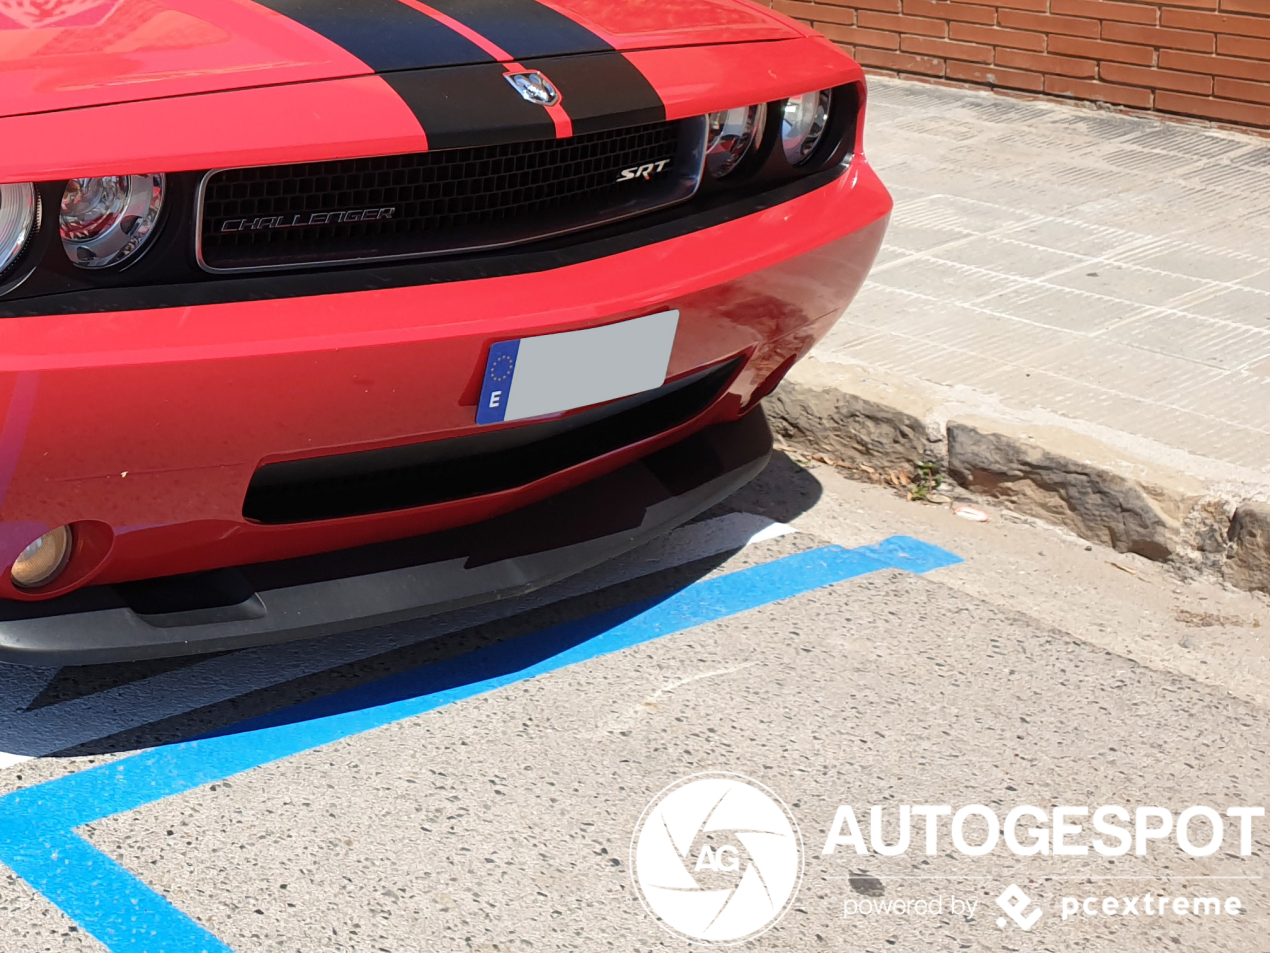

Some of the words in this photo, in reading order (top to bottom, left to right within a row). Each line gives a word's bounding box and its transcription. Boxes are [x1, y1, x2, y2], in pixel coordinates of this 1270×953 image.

[616, 159, 670, 181] SRT
[221, 207, 395, 232] CHALLENGER
[488, 390, 503, 408] E
